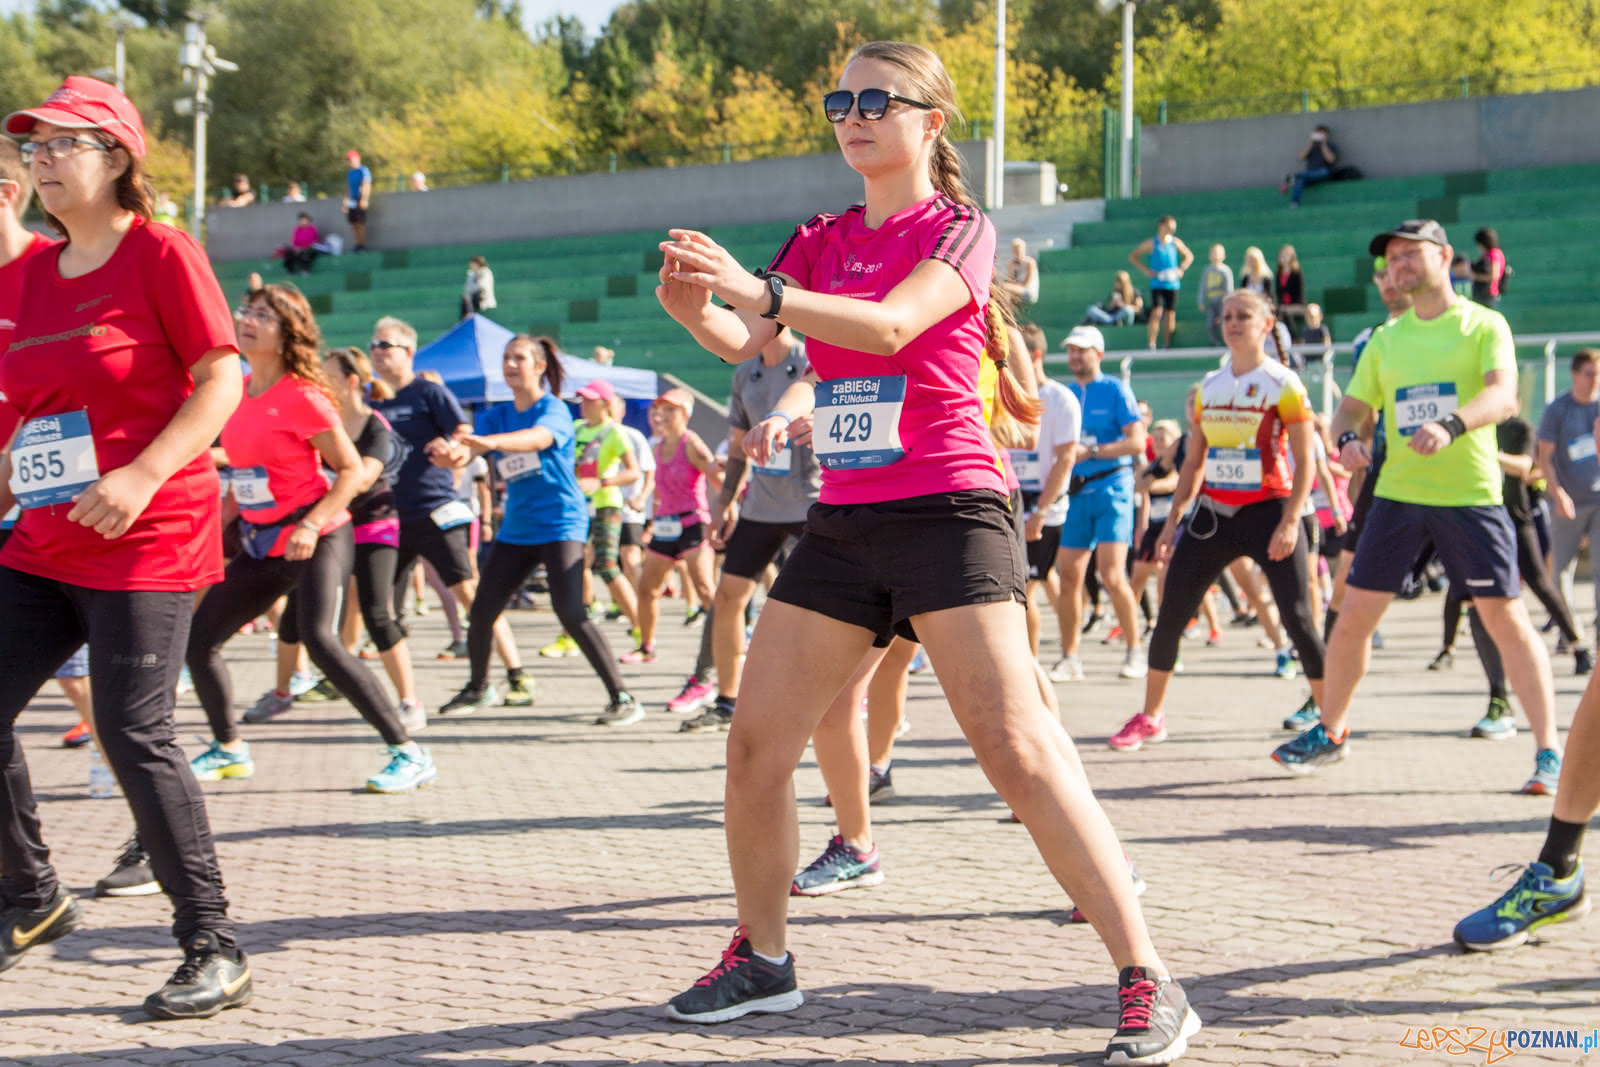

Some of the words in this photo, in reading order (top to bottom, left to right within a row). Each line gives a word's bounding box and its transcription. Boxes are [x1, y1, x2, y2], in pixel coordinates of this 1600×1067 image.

[832, 379, 880, 394] zaBIEGaj
[832, 397, 838, 405] o
[839, 394, 878, 404] FUNdusze
[1408, 402, 1437, 422] 359
[829, 411, 872, 443] 429
[19, 450, 64, 483] 655
[1216, 464, 1245, 480] 536
